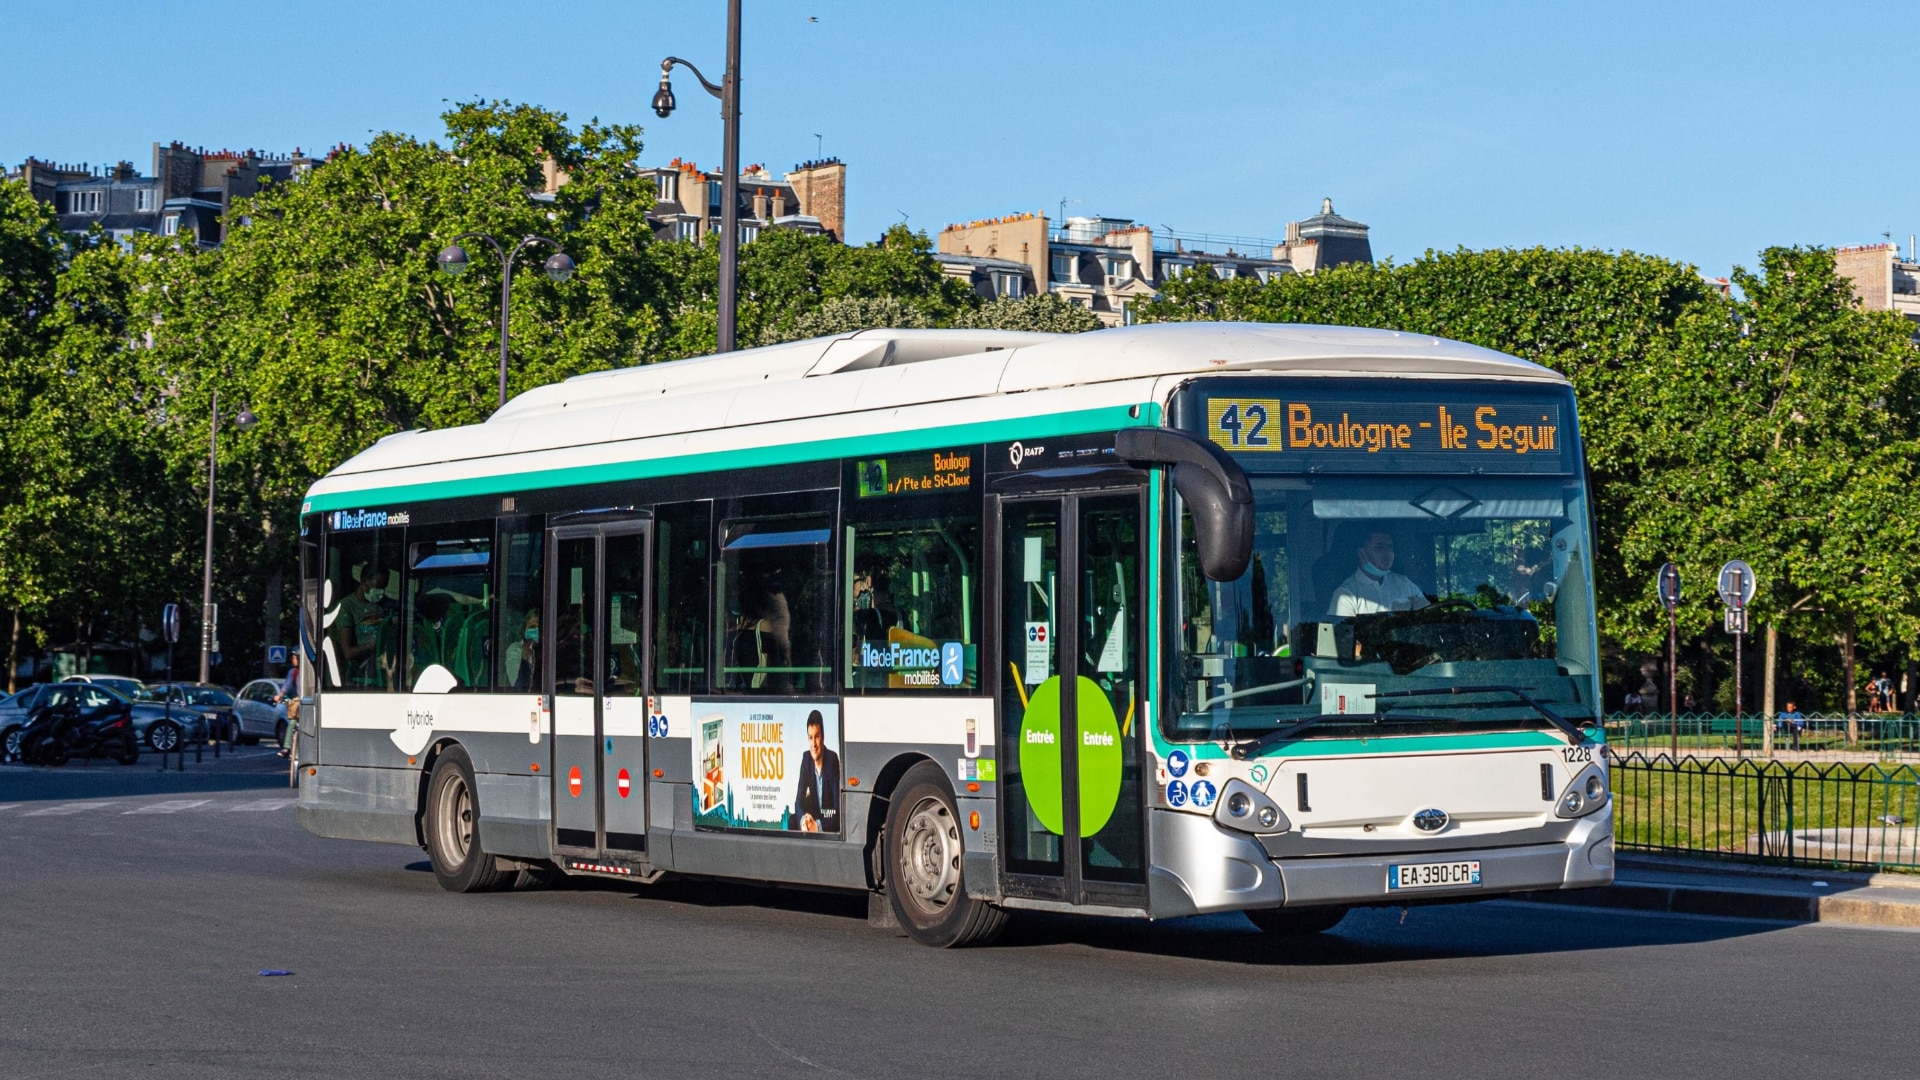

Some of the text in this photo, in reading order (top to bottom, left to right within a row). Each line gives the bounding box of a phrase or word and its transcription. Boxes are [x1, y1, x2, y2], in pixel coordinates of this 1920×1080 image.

[1219, 403, 1268, 446] 42
[1288, 403, 1411, 452] Boulogne
[1024, 446, 1044, 457] RATP
[903, 477, 919, 491] Pte
[921, 475, 932, 489] de
[387, 511, 409, 525] mobilités
[904, 669, 940, 686] mobilités
[407, 709, 434, 730] Hybride
[740, 722, 784, 744] GUILLAUME
[1026, 729, 1055, 744] Entrée
[1083, 731, 1113, 746] Entrée
[1561, 747, 1591, 763] 1228
[741, 746, 784, 781] MUSSO
[1472, 872, 1480, 881] 75
